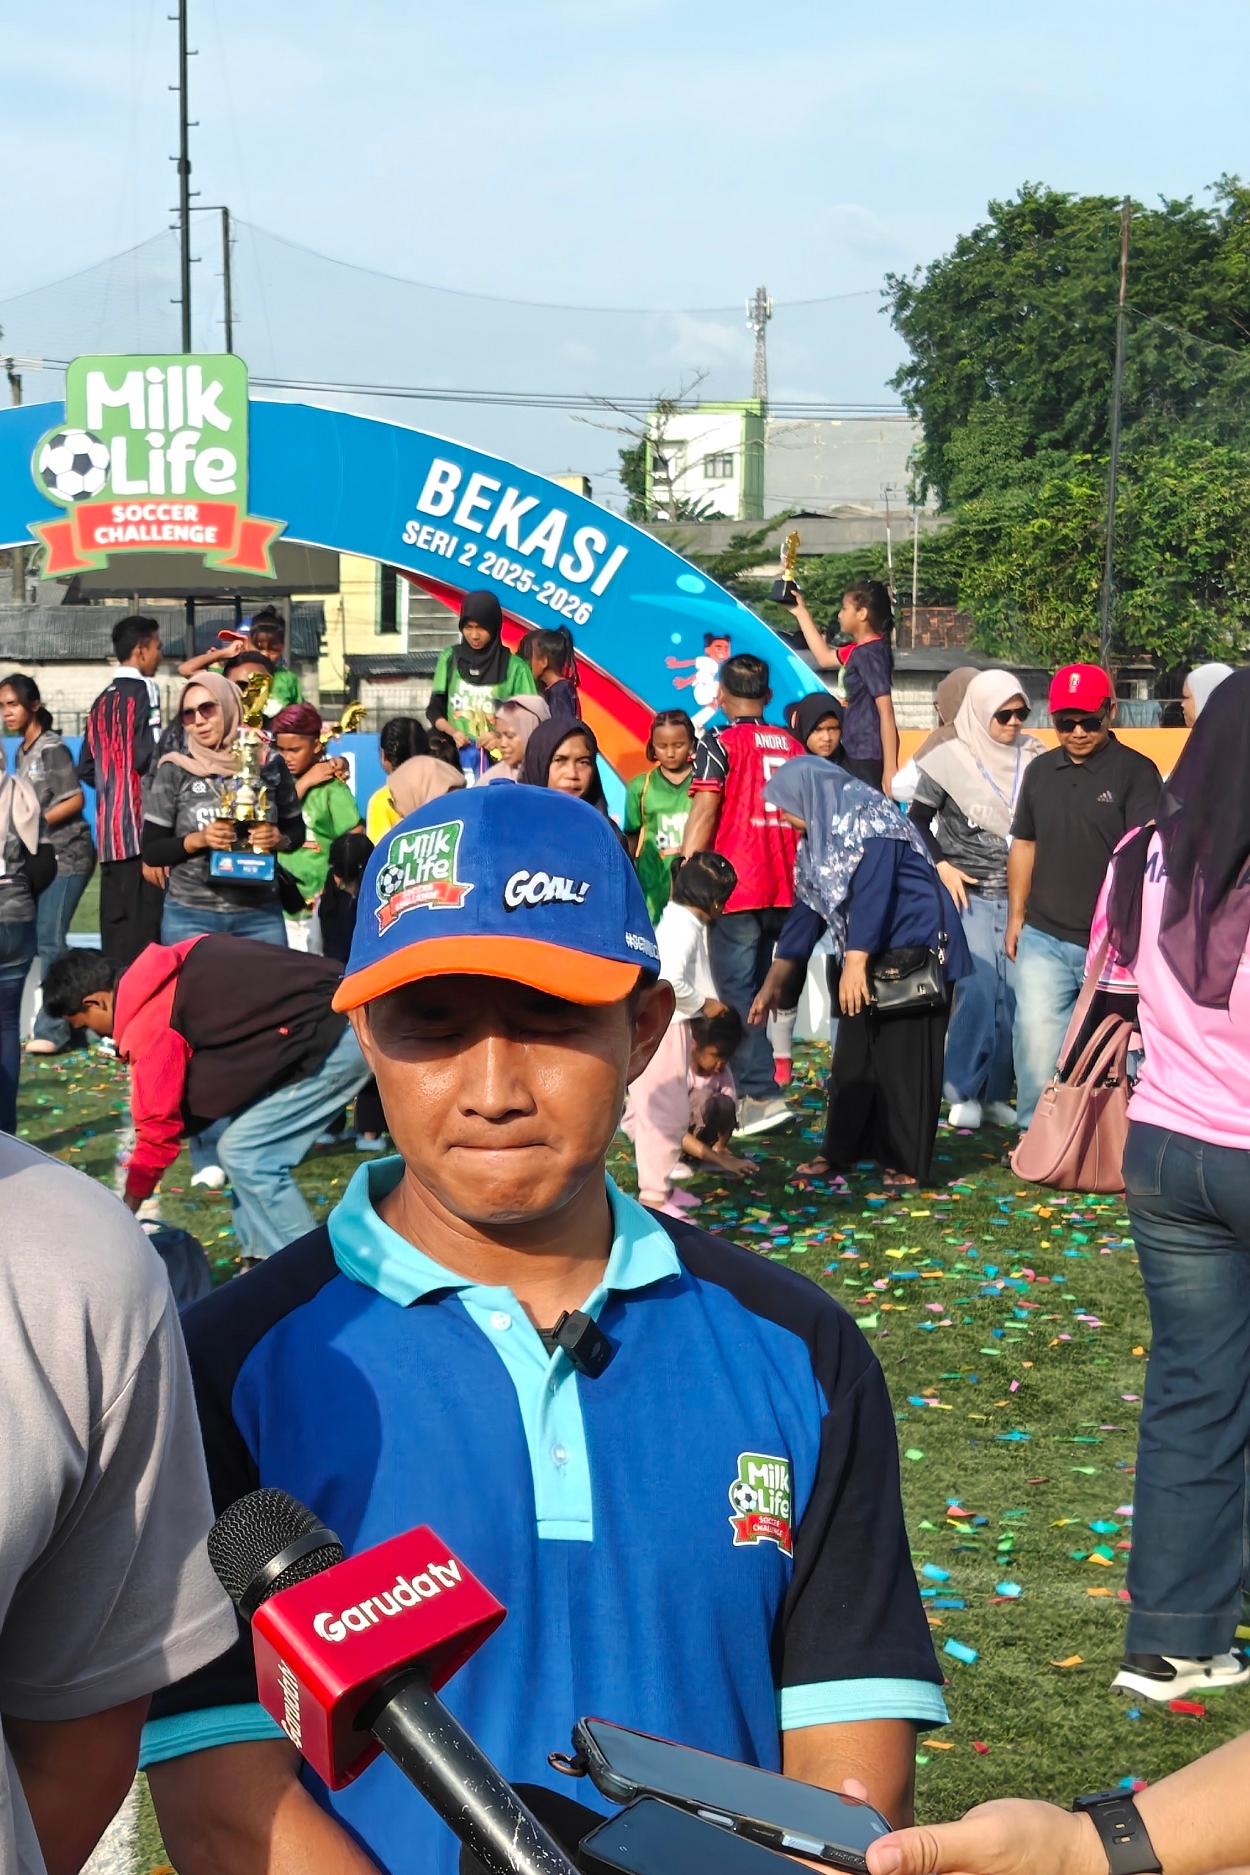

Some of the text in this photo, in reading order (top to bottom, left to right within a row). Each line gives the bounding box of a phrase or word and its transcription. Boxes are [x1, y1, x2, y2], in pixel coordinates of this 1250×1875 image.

[86, 364, 232, 433] Milk
[111, 430, 238, 496] Life
[112, 504, 199, 523] SOCCER
[416, 457, 629, 597] BEKASI
[93, 525, 218, 545] CHALLENGE
[402, 520, 594, 626] SERI 2 2025-2026
[754, 732, 789, 751] ANDRE
[398, 829, 451, 865] Milk
[403, 854, 450, 889] Life
[503, 869, 592, 909] GOAL!
[747, 1461, 790, 1494] Milk
[757, 1488, 790, 1519] Life
